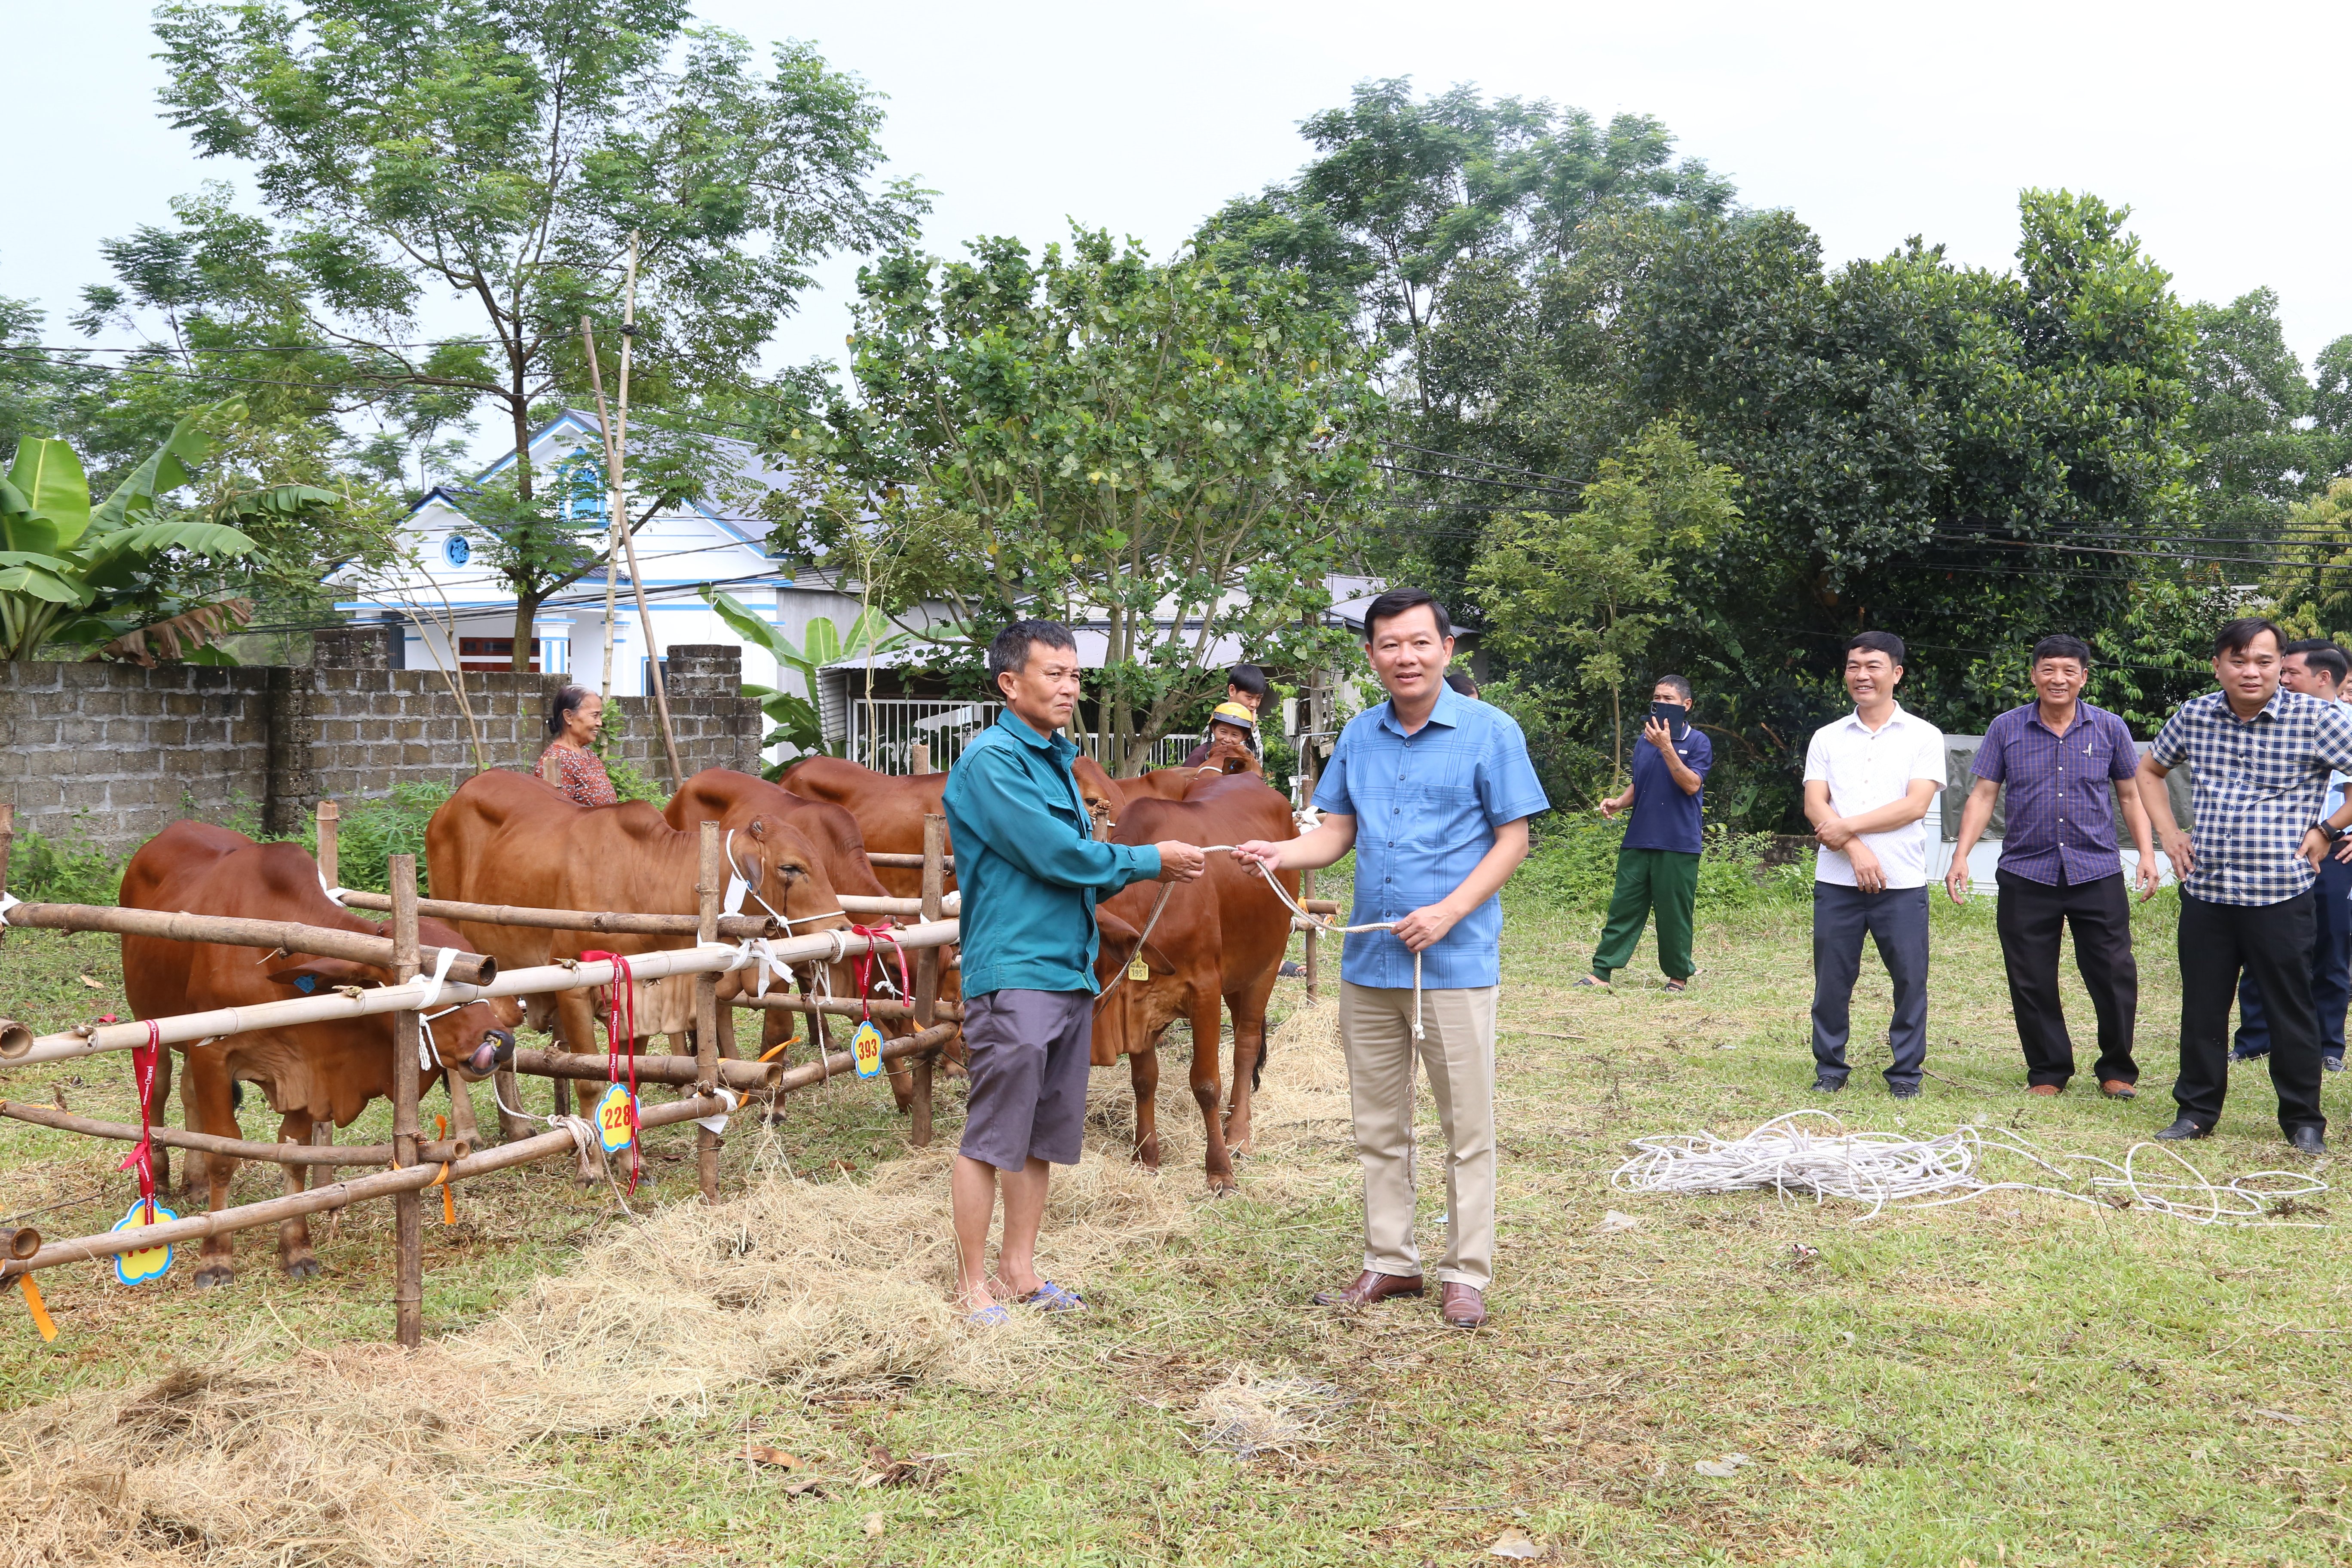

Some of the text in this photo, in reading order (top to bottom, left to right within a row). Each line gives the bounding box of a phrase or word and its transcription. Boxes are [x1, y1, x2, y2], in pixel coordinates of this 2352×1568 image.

[859, 1038, 877, 1060] 393
[144, 1066, 153, 1085] Chanel
[605, 1104, 631, 1130] 228
